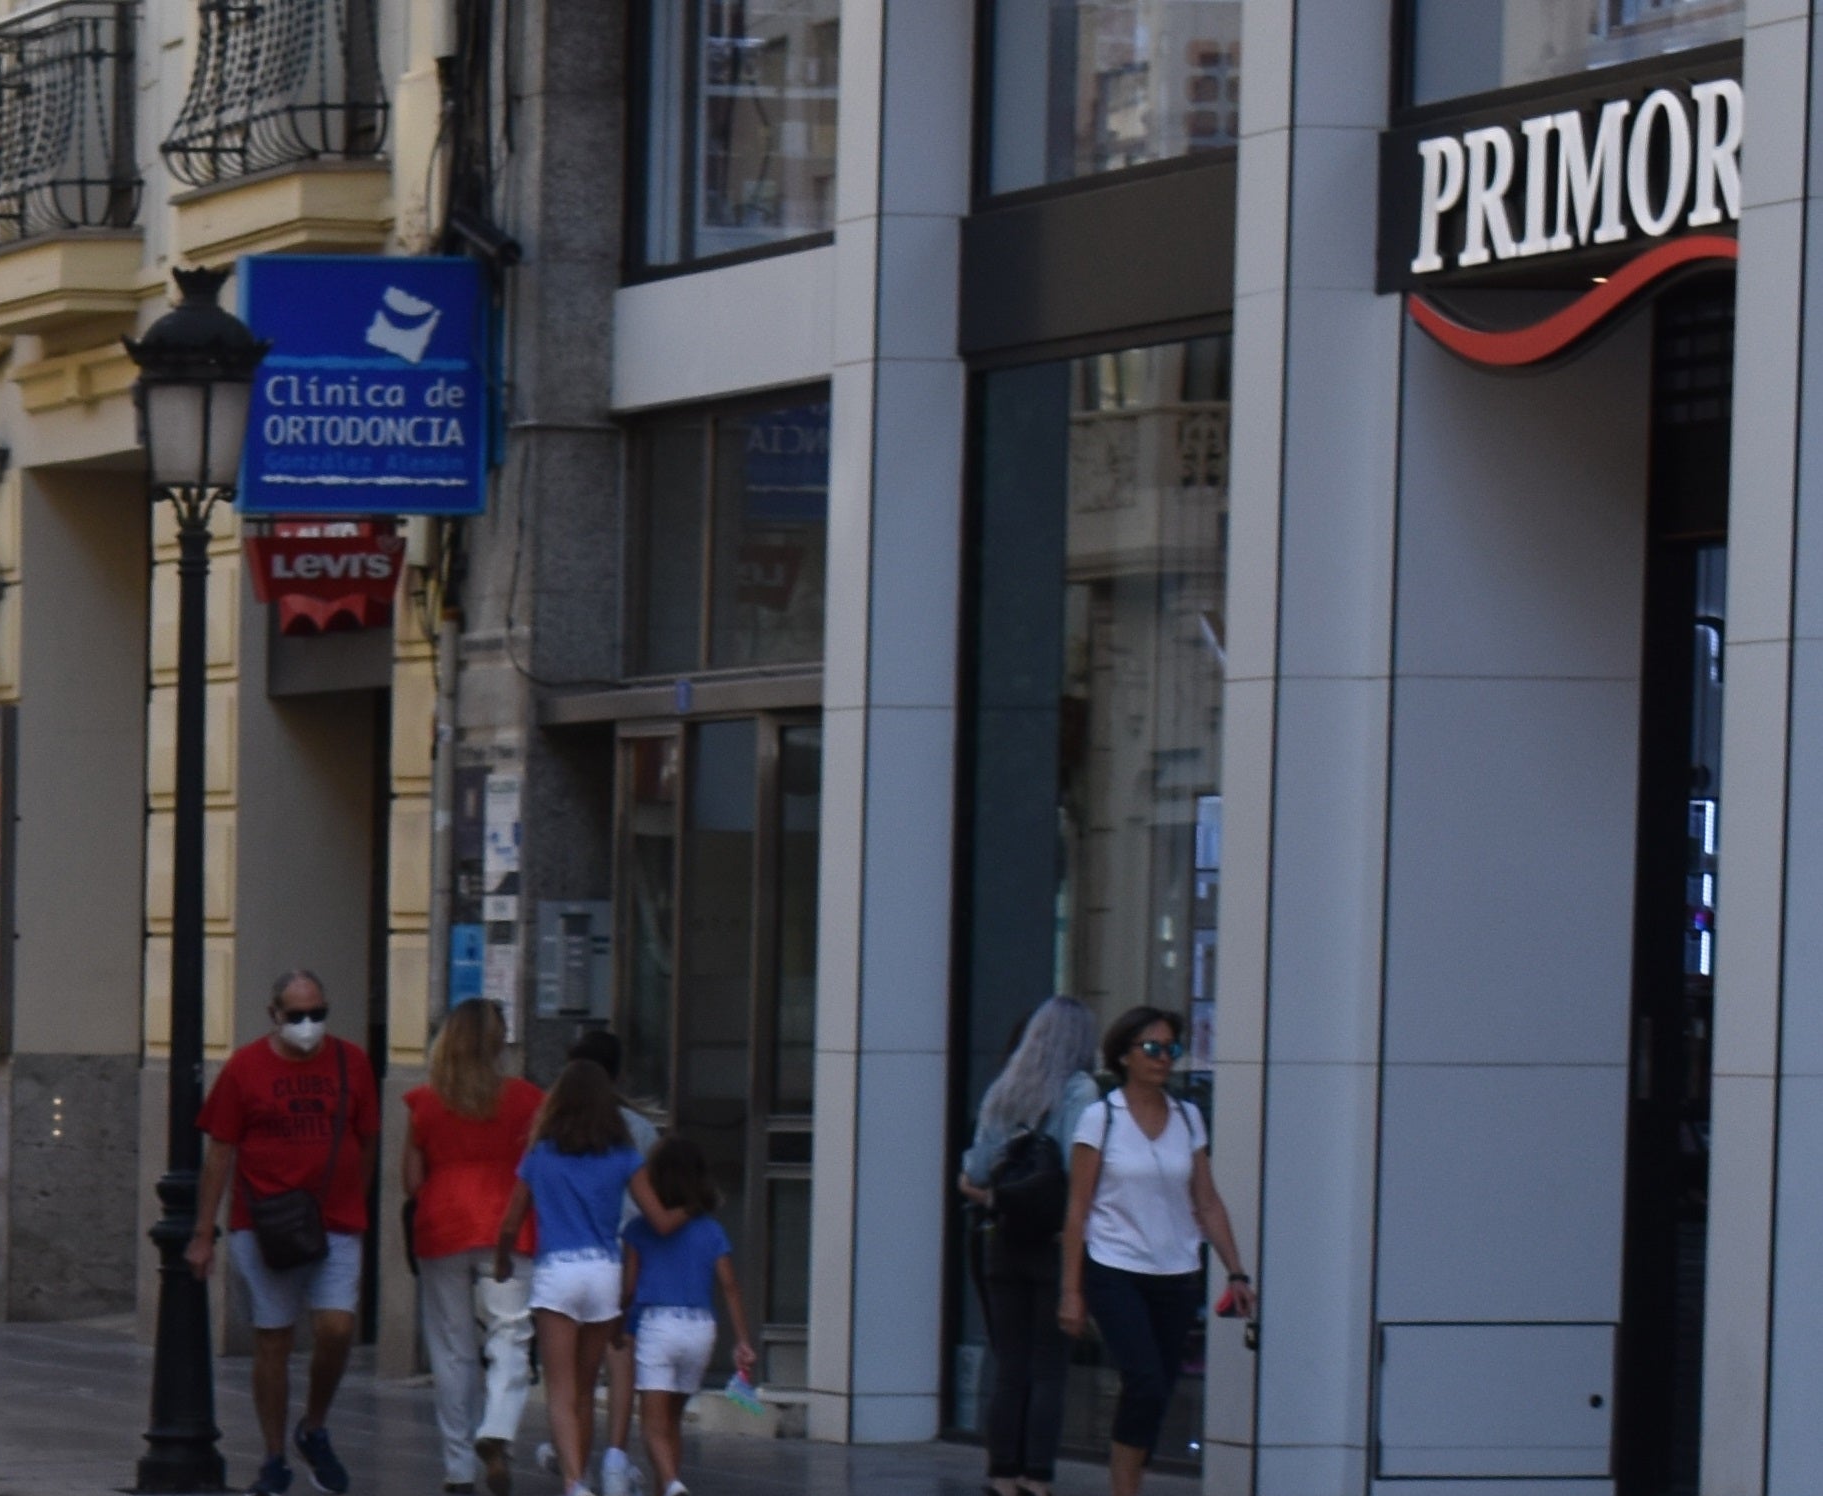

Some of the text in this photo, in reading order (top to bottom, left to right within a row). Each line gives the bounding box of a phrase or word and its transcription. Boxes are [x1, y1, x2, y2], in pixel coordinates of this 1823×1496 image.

[1410, 78, 1744, 274] PRIMOR
[265, 375, 465, 407] Clínica de
[264, 414, 464, 447] ORTODONCIA
